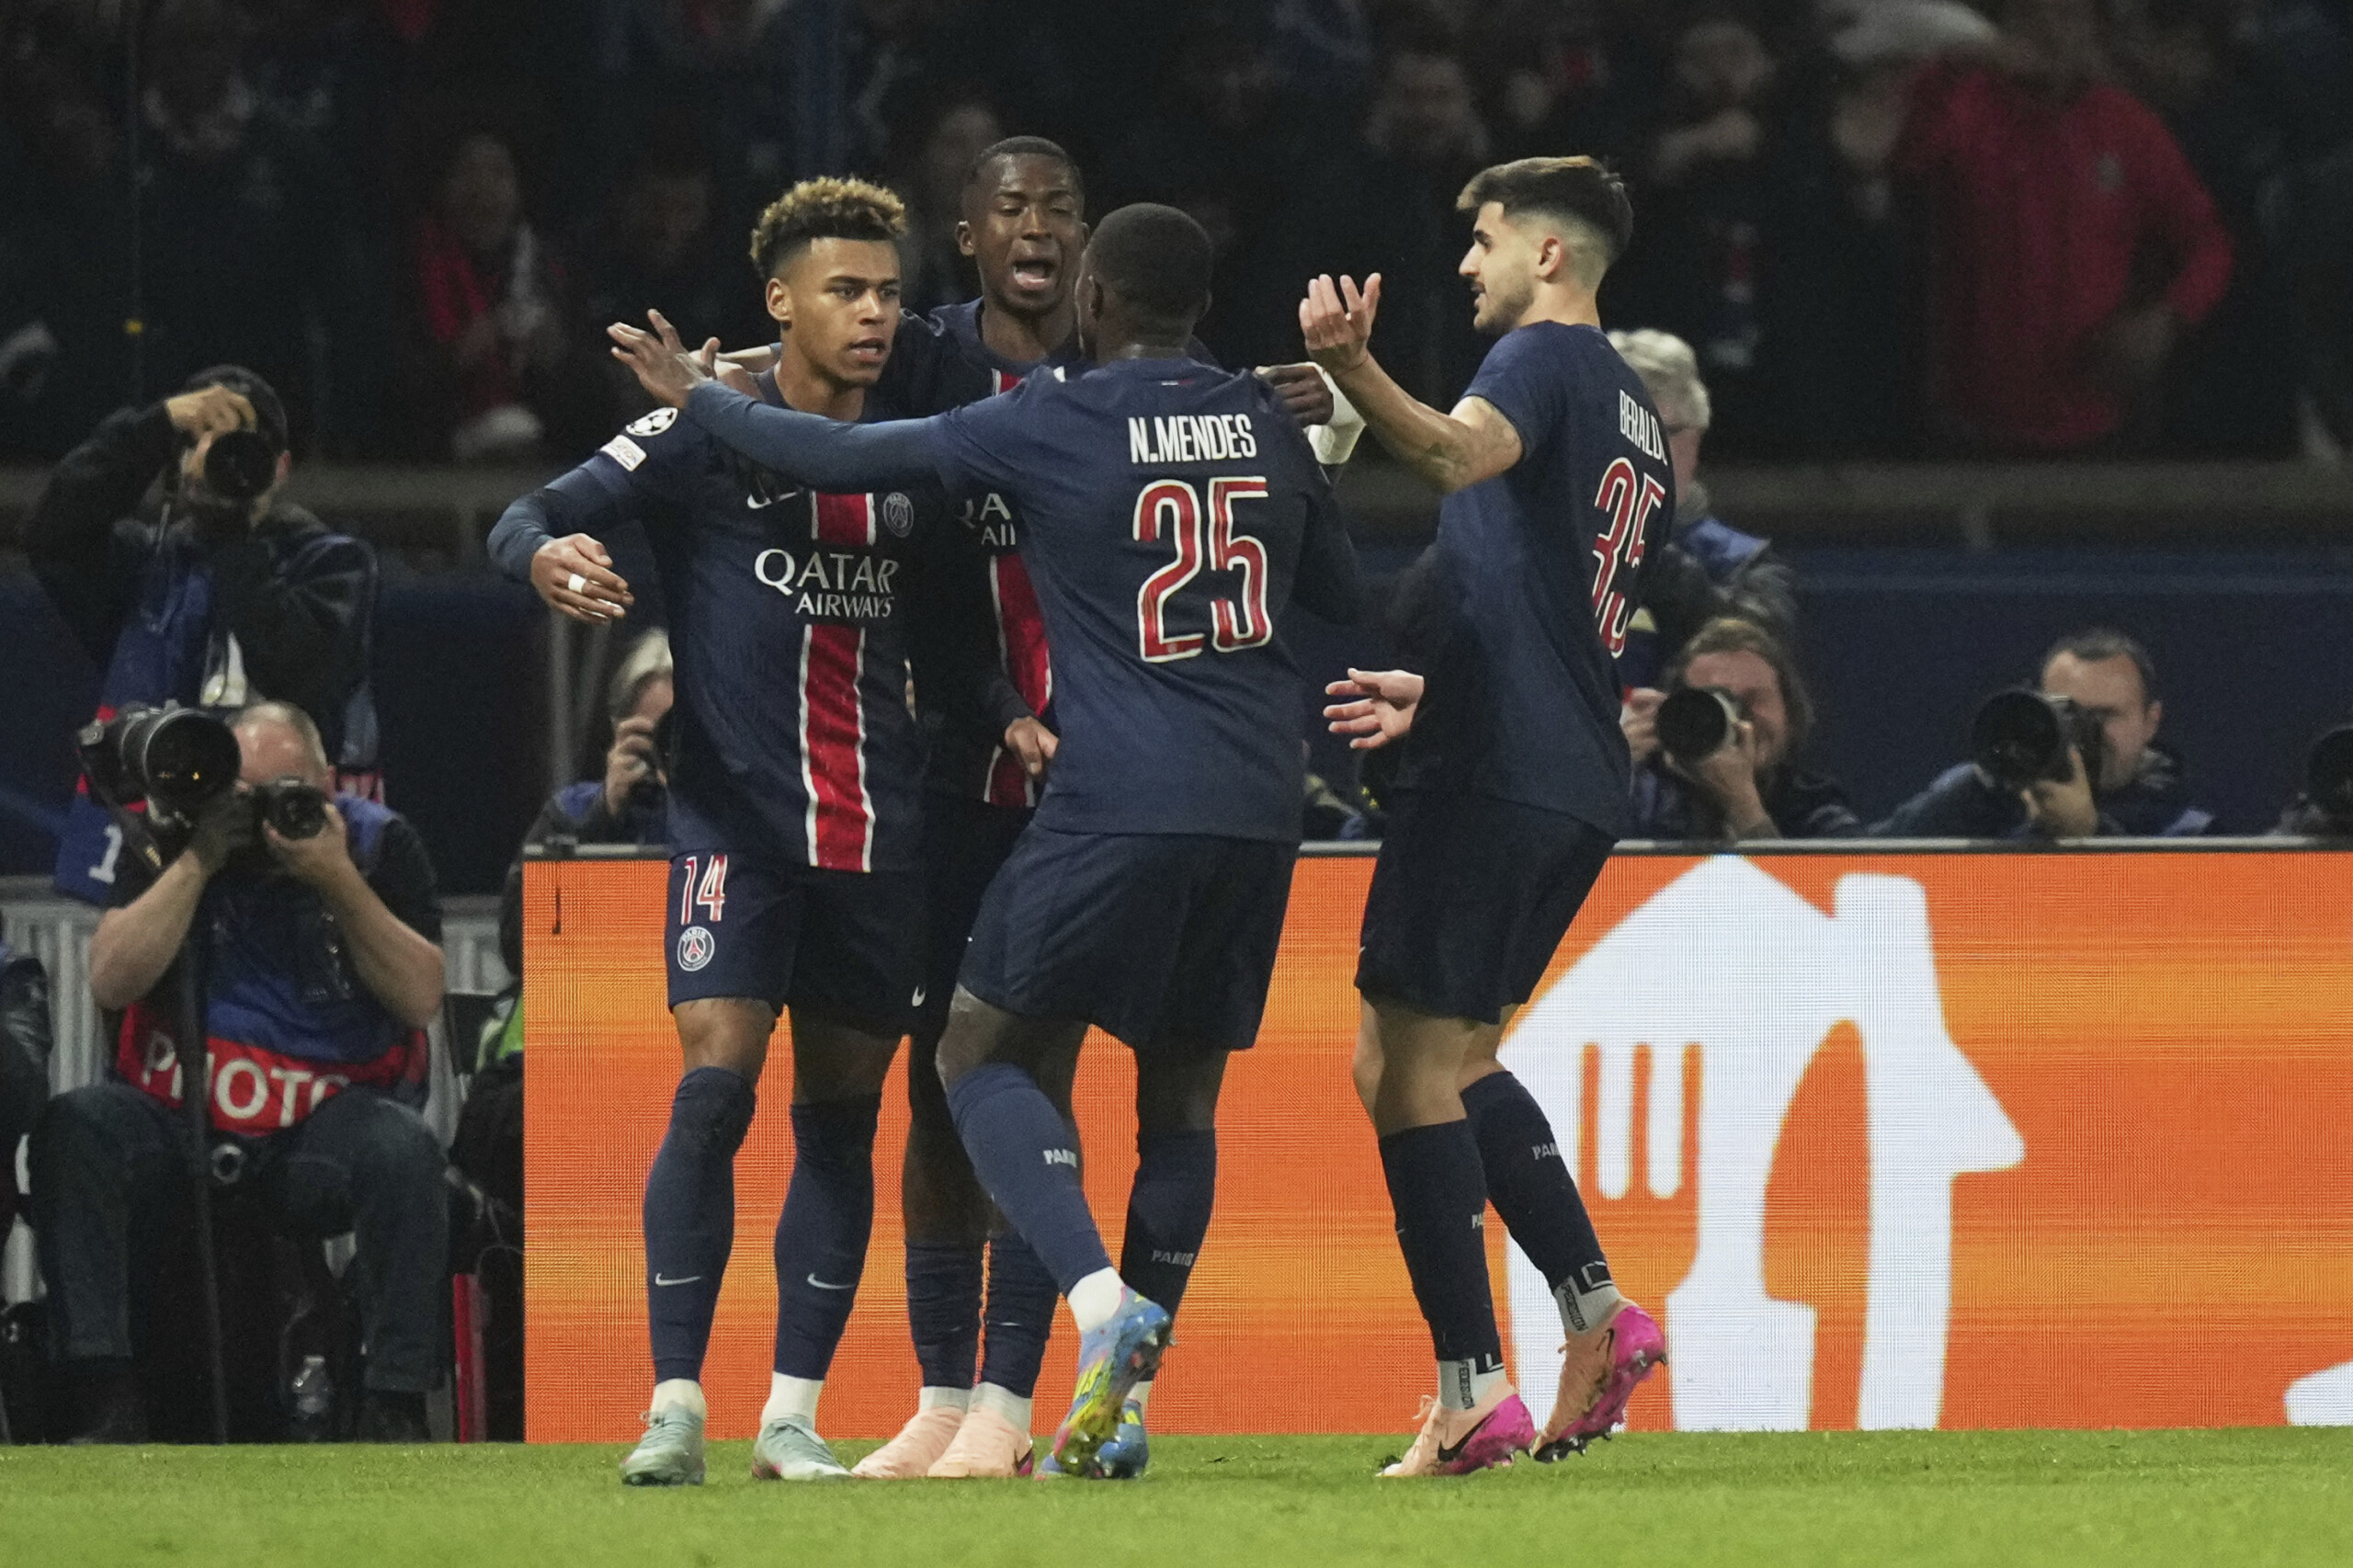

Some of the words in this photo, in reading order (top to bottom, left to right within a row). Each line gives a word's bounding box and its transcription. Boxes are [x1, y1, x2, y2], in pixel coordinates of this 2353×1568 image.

[1128, 414, 1257, 463] N.MENDES
[755, 548, 900, 597] QATAR
[1132, 475, 1273, 662] 25
[1592, 457, 1666, 659] 35
[794, 591, 895, 618] AIRWAYS
[681, 854, 728, 926] 14
[681, 928, 707, 943] PARIS
